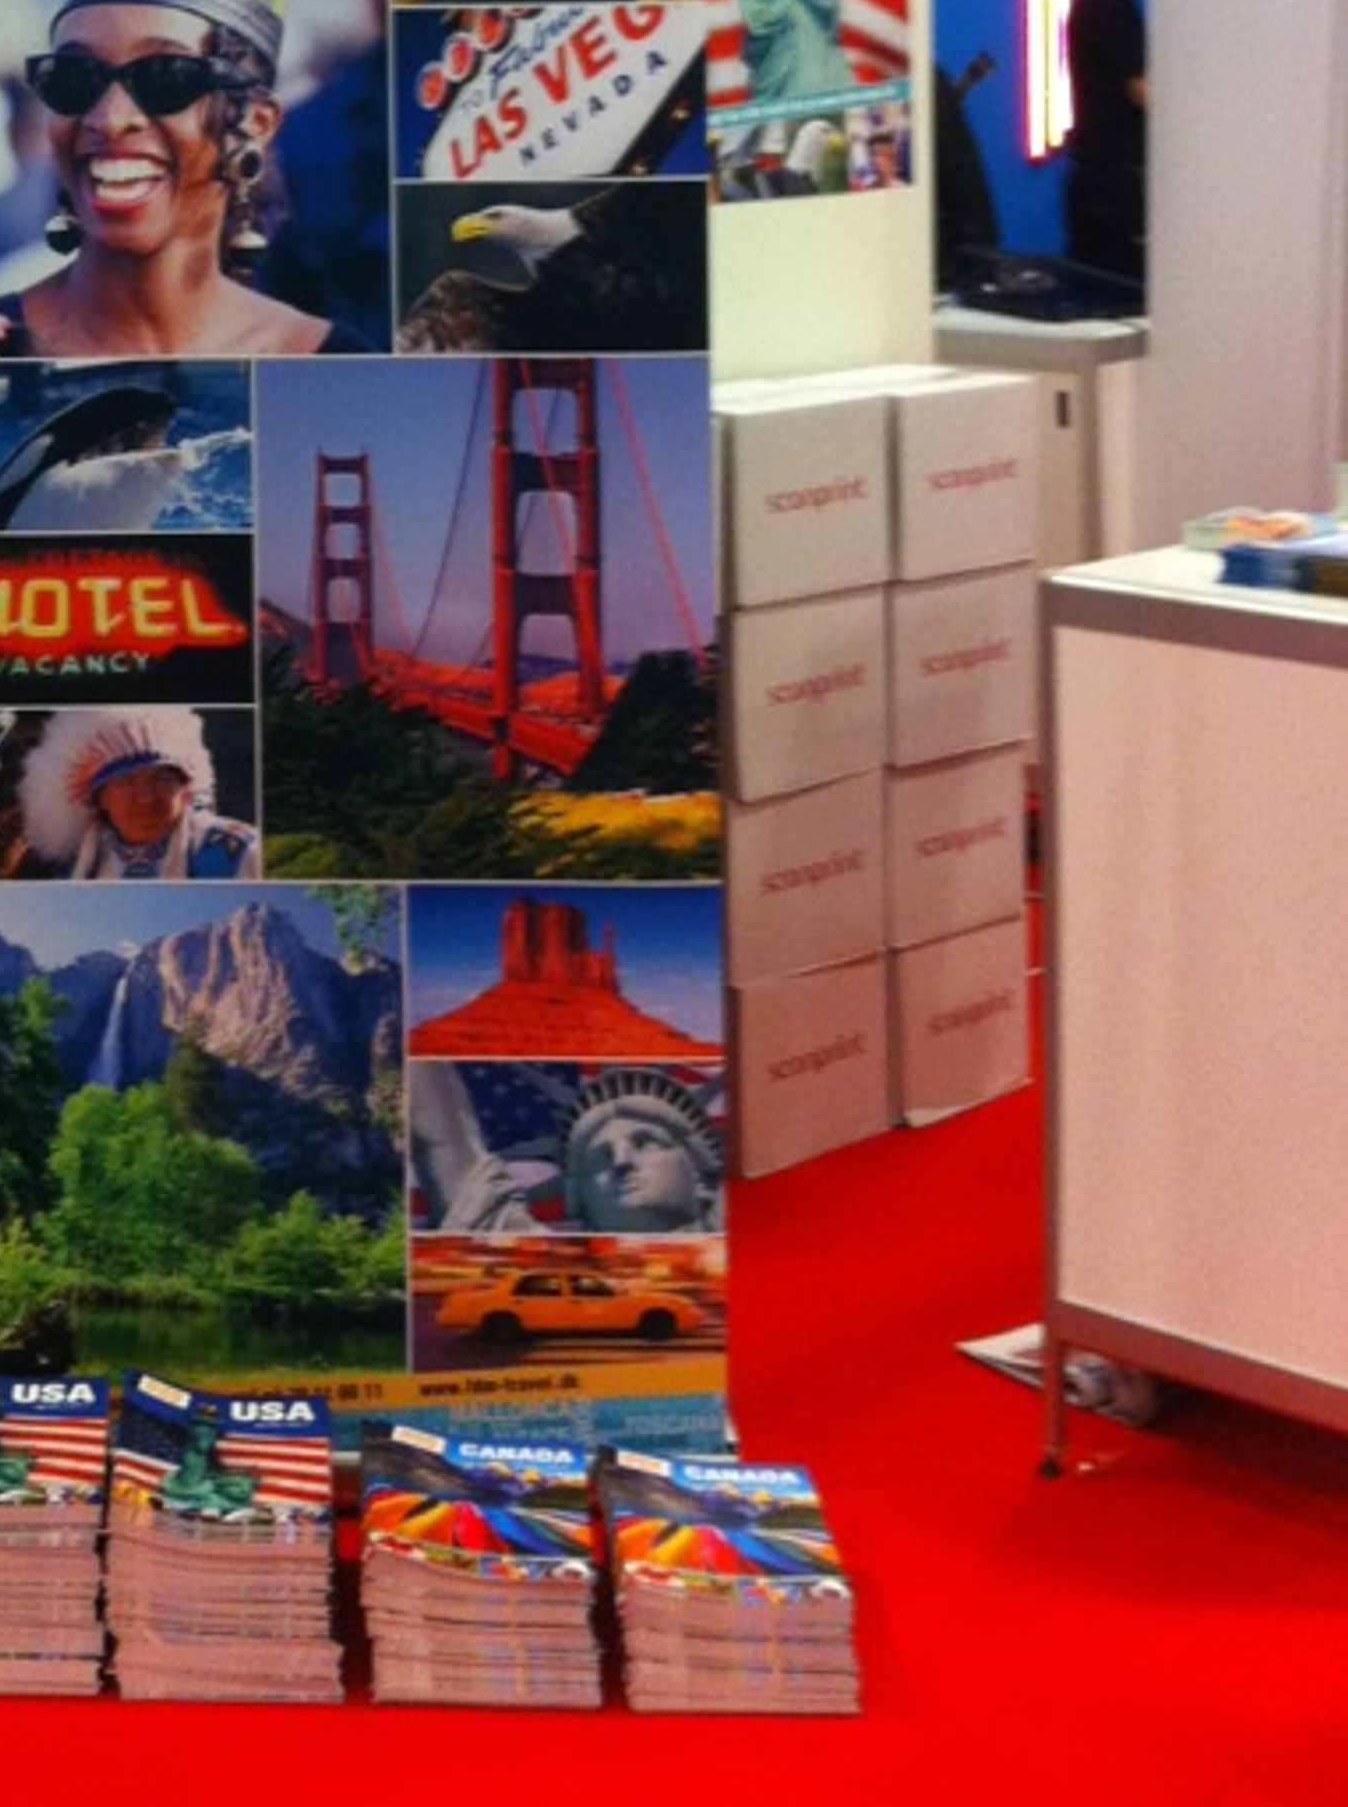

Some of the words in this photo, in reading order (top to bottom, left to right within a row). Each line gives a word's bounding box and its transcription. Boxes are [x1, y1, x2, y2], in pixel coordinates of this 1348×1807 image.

[518, 49, 668, 165] NEVADA
[448, 87, 528, 179] LAS
[10, 1381, 97, 1406] USA
[228, 1399, 316, 1424] USA
[457, 1443, 575, 1465] CANADA
[681, 1464, 802, 1486] CANADA
